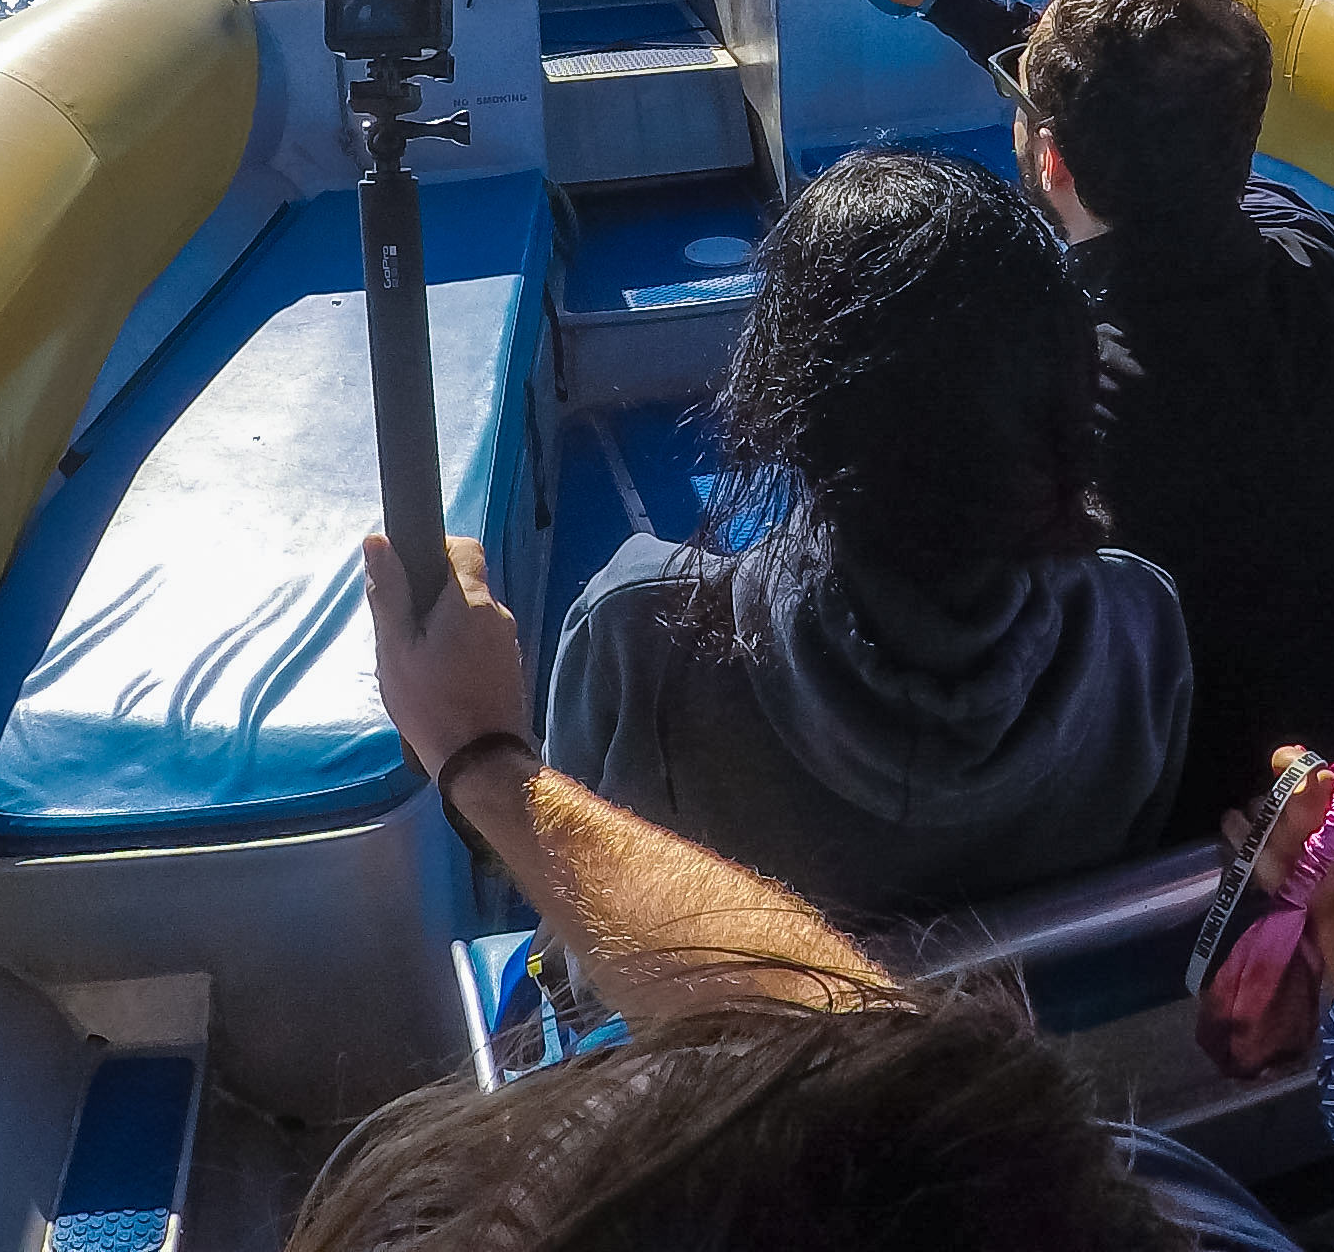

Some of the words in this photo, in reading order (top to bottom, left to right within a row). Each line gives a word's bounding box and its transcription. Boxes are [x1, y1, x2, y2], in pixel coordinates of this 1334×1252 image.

[453, 98, 469, 107] NO
[476, 93, 528, 105] SMOKING
[382, 245, 392, 289] GoPro
